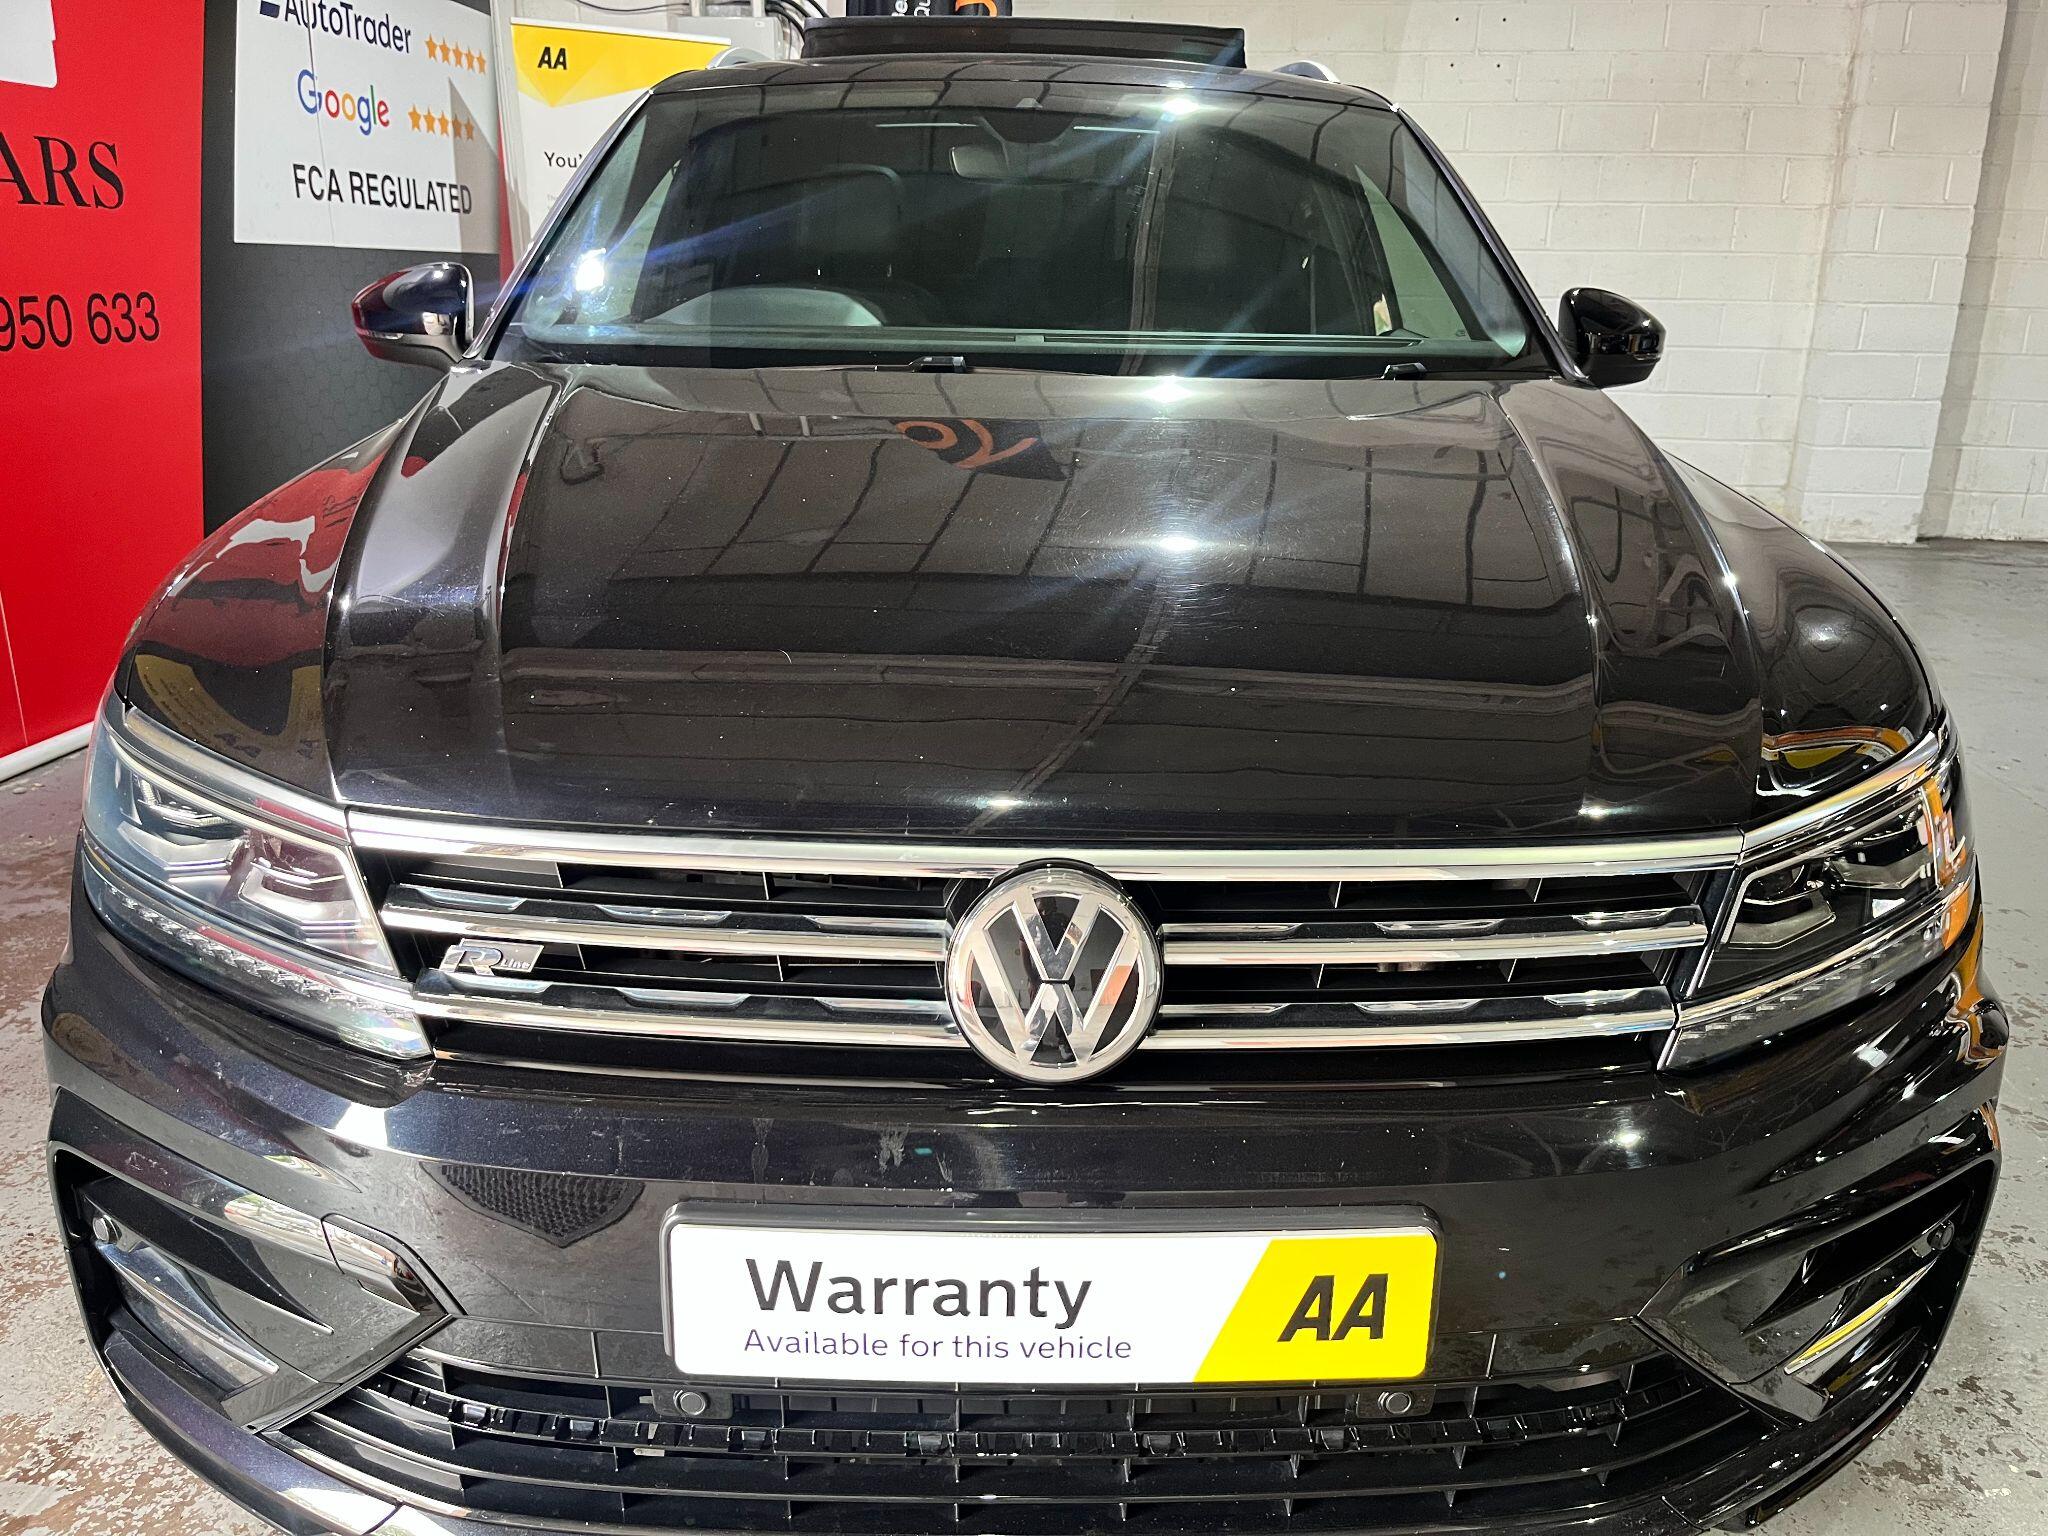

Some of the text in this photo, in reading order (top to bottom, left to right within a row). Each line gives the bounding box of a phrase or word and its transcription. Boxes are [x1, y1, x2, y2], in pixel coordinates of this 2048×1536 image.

[284, 0, 411, 53] AutoTrader
[537, 46, 567, 70] AA
[298, 69, 389, 136] Google
[293, 163, 472, 214] FCA REGULATED
[87, 291, 160, 344] 633
[745, 1258, 1092, 1330] Warranty
[1277, 1273, 1388, 1342] AA
[744, 1328, 1132, 1359] Available for this vehicle
